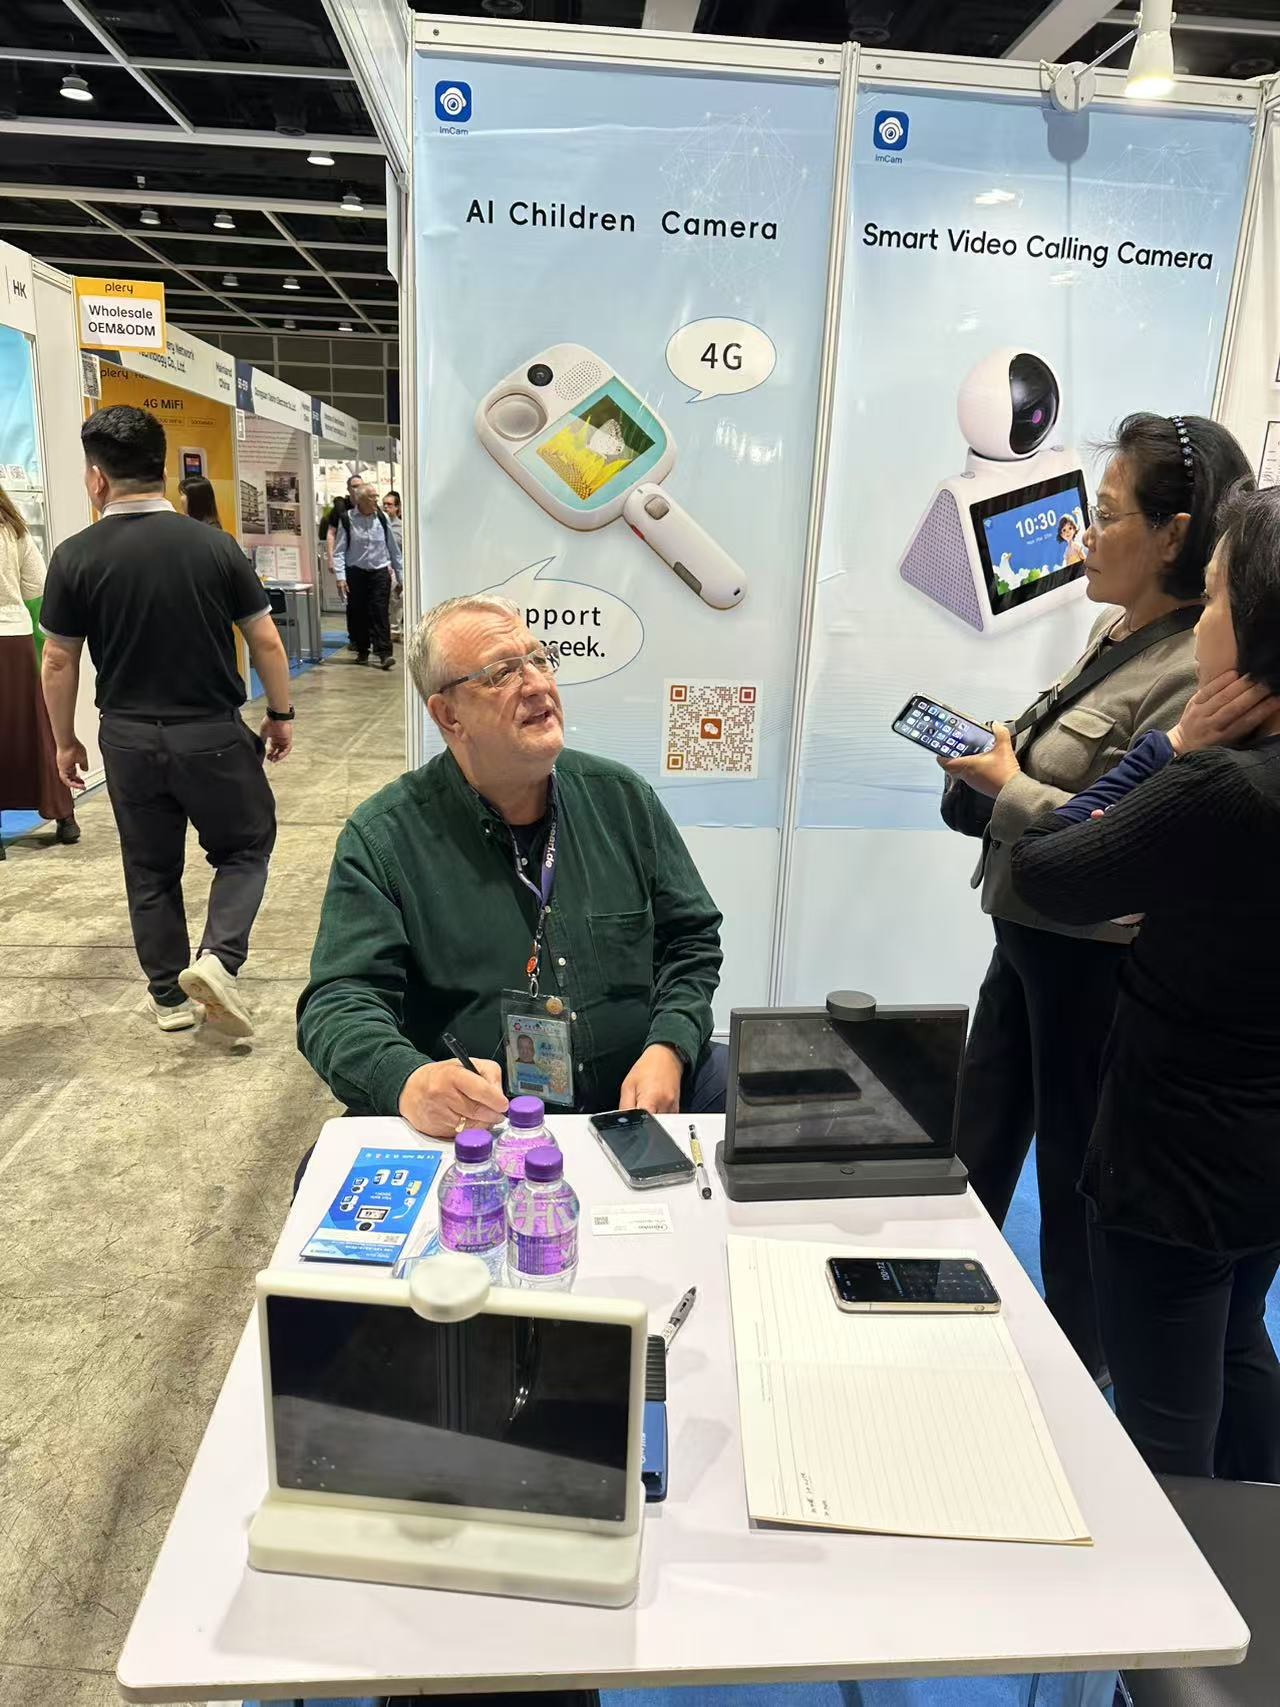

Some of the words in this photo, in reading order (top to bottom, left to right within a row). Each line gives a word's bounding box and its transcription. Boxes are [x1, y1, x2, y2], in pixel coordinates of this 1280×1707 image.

[439, 126, 469, 136] ImCam
[875, 153, 903, 164] ImCam
[466, 199, 494, 224] AI
[509, 201, 636, 232] Children
[661, 210, 778, 240] Camera
[862, 222, 939, 250] Smart
[947, 228, 1018, 256] Video
[1026, 234, 1109, 269] Calling
[1117, 241, 1214, 270] Camera
[12, 279, 27, 299] HK
[104, 282, 134, 295] plery
[88, 304, 153, 320] Wholesale
[88, 321, 156, 337] OEM&ODM
[700, 342, 744, 371] 4G
[101, 367, 129, 380] plery
[143, 399, 158, 409] 4G
[161, 399, 184, 410] MiFi
[1015, 510, 1057, 538] 10:30
[518, 606, 601, 630] pport
